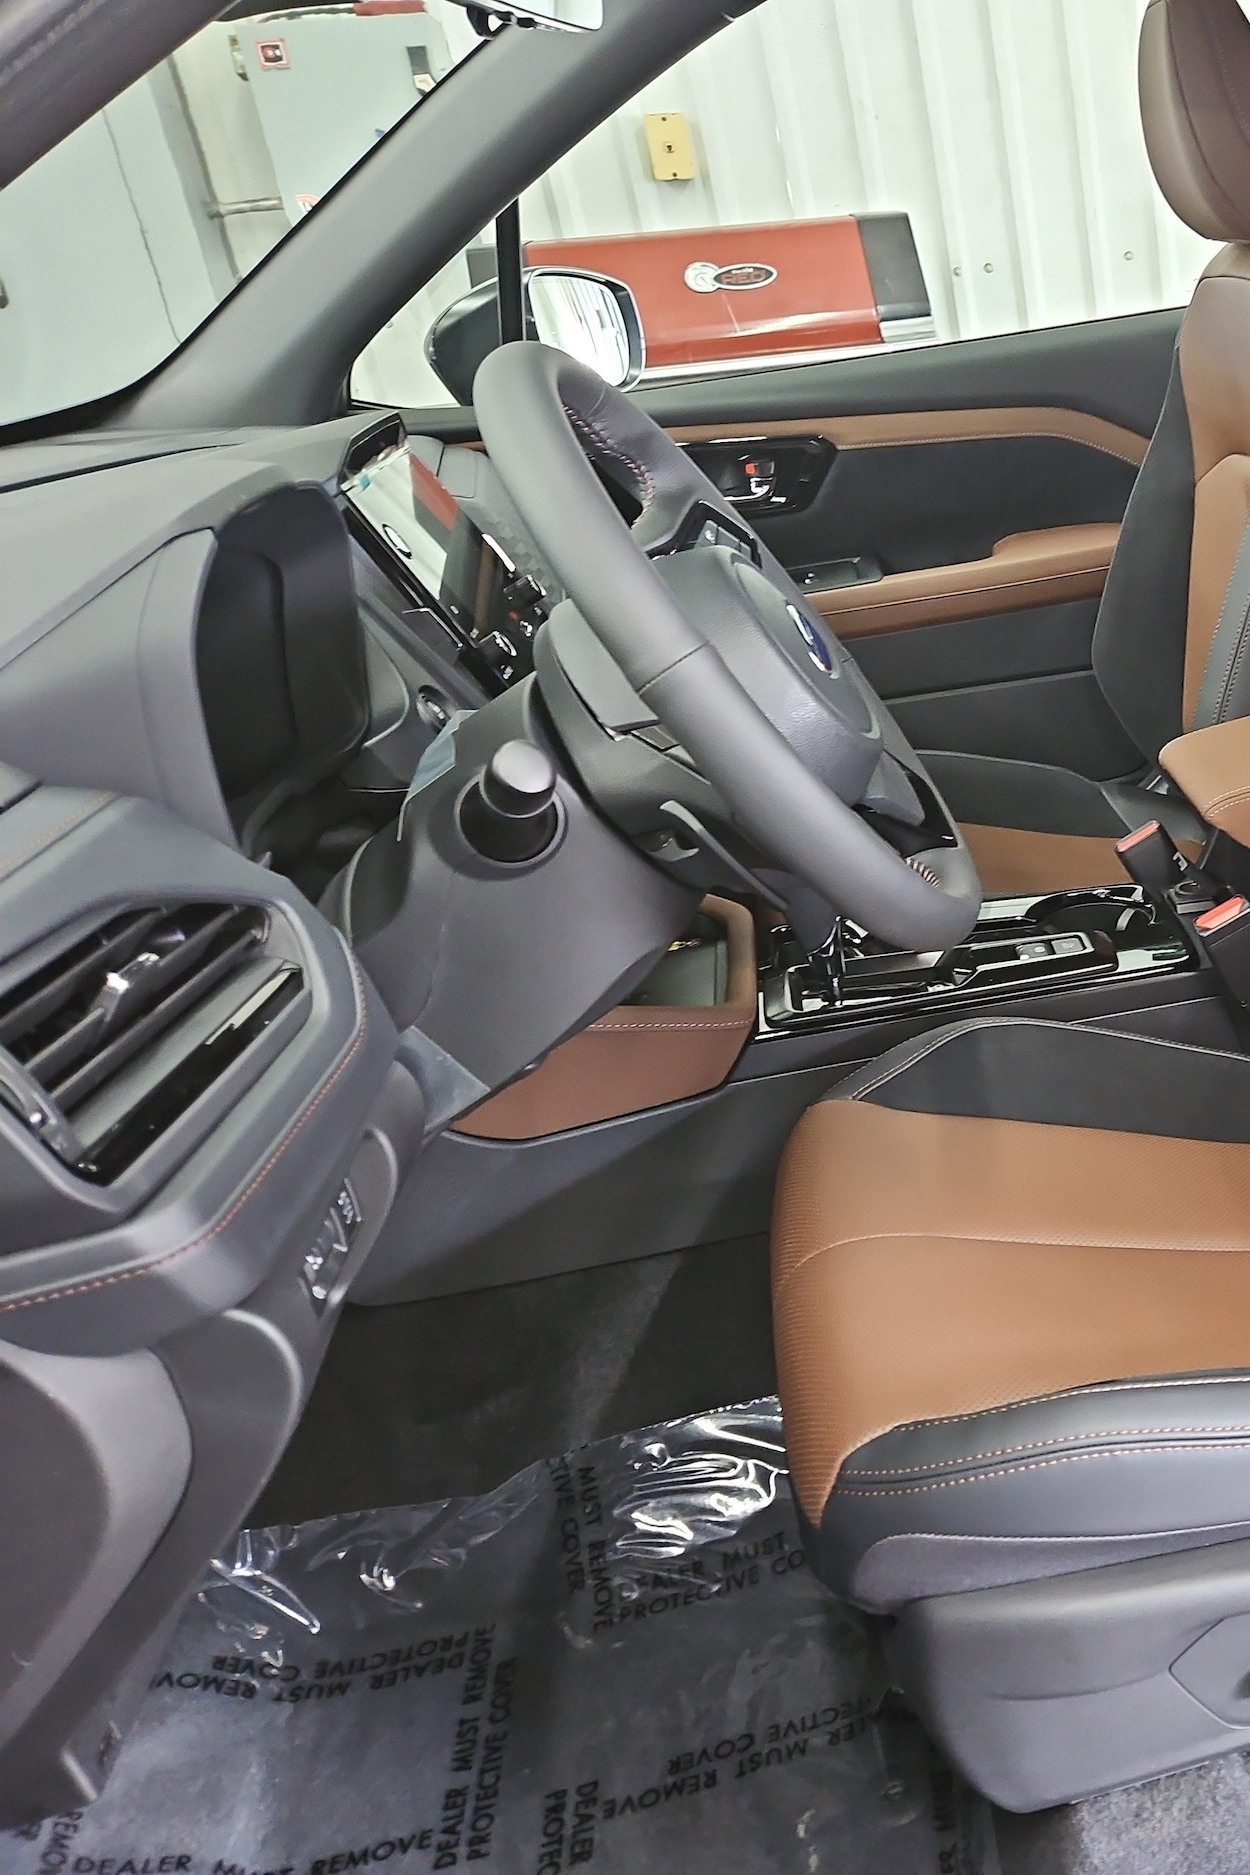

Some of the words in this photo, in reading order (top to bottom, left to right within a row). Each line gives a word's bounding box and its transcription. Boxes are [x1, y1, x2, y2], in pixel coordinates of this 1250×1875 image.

[561, 1517, 586, 1595] COVER
[722, 1531, 786, 1569] MUST
[588, 1539, 614, 1632] REMOVE
[212, 1655, 302, 1684] COVER
[313, 1631, 471, 1680] PROTECTIVE
[369, 1651, 466, 1692] DEALER
[462, 1622, 497, 1706] REMOVE
[451, 1716, 481, 1773] MUST
[466, 1728, 508, 1862] PROTECTIVE
[488, 1656, 518, 1725] COVER
[667, 1731, 757, 1776] COVER
[733, 1737, 808, 1781] MUST
[602, 1767, 719, 1821] REMOVE
[431, 1784, 471, 1872] DEALER
[567, 1778, 599, 1867] DEALER
[72, 1853, 192, 1875] DEALER
[309, 1829, 435, 1875] REMOVE
